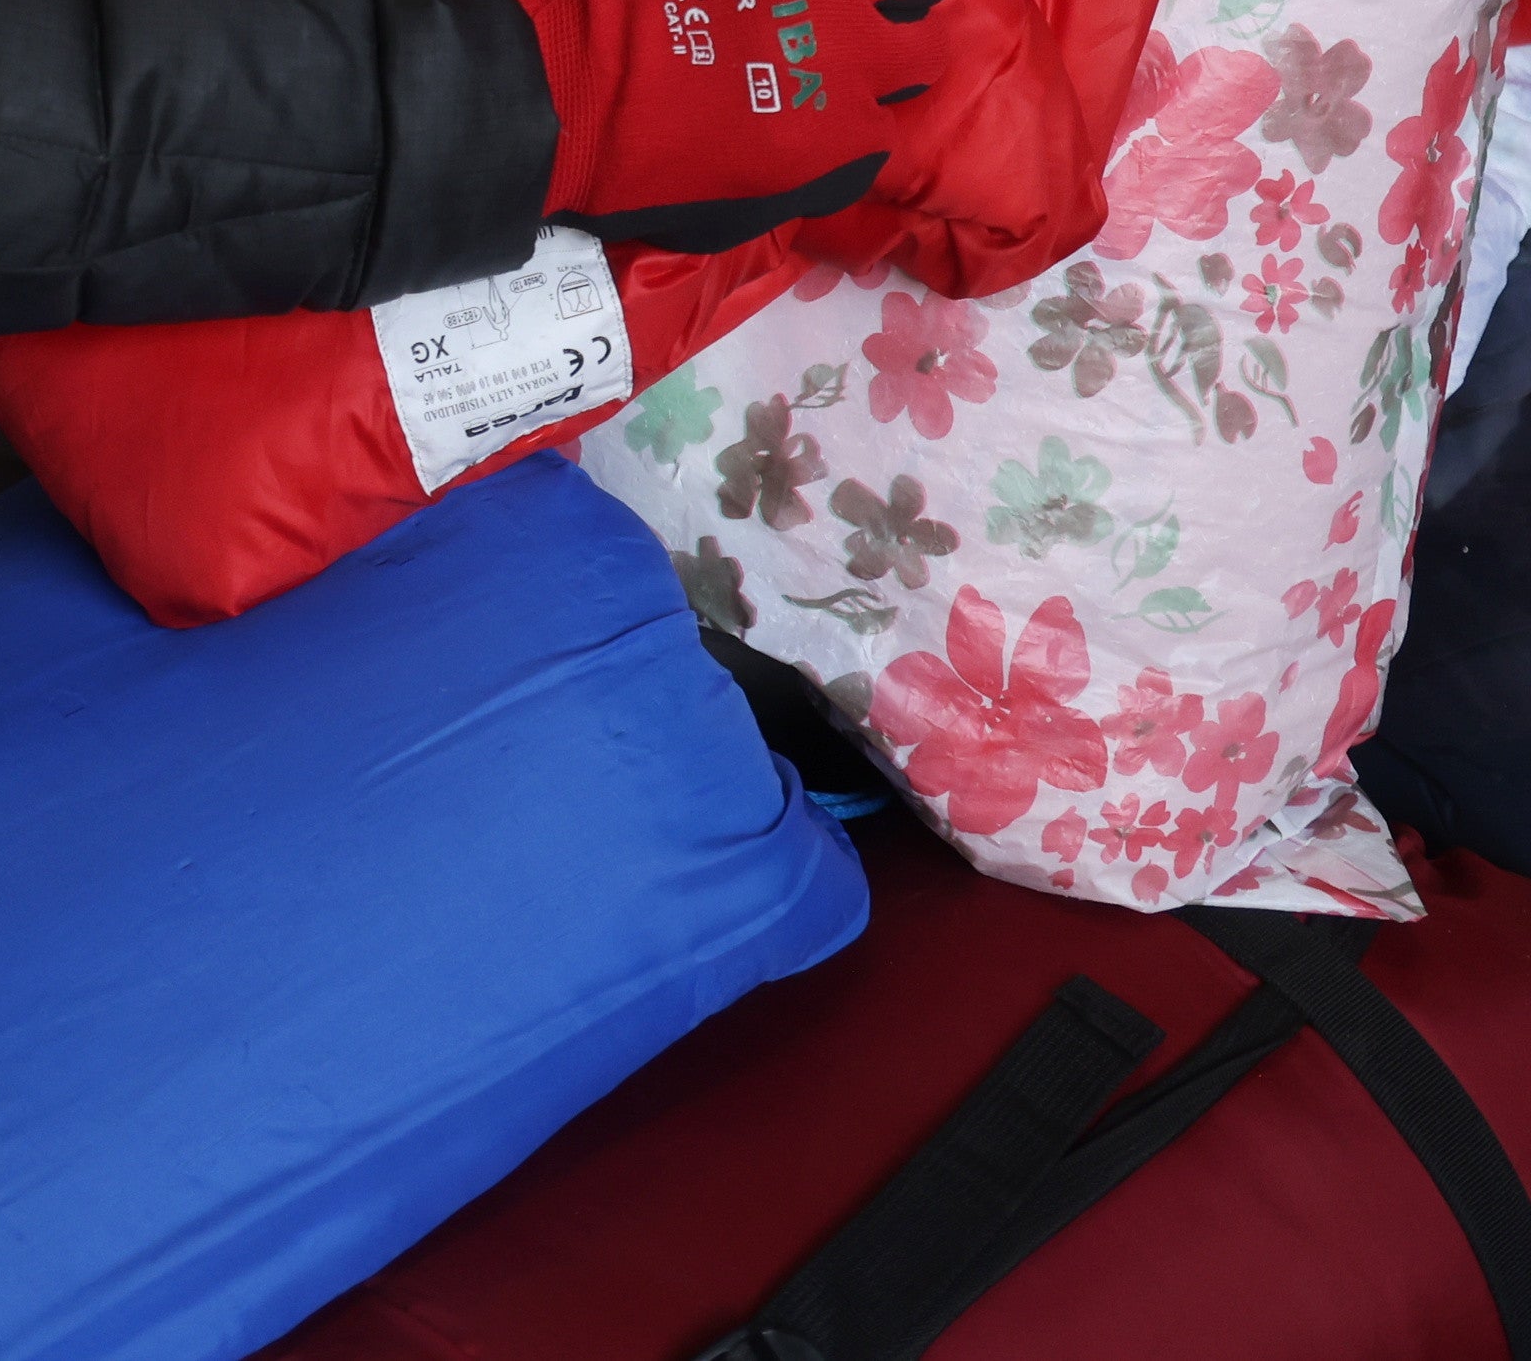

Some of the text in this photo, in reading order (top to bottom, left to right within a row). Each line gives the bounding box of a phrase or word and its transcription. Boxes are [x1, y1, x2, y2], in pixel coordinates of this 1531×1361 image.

[754, 79, 773, 101] 10
[414, 363, 462, 383] TALLA
[423, 371, 559, 422] ANORAK ALTA VISIBILIDAD
